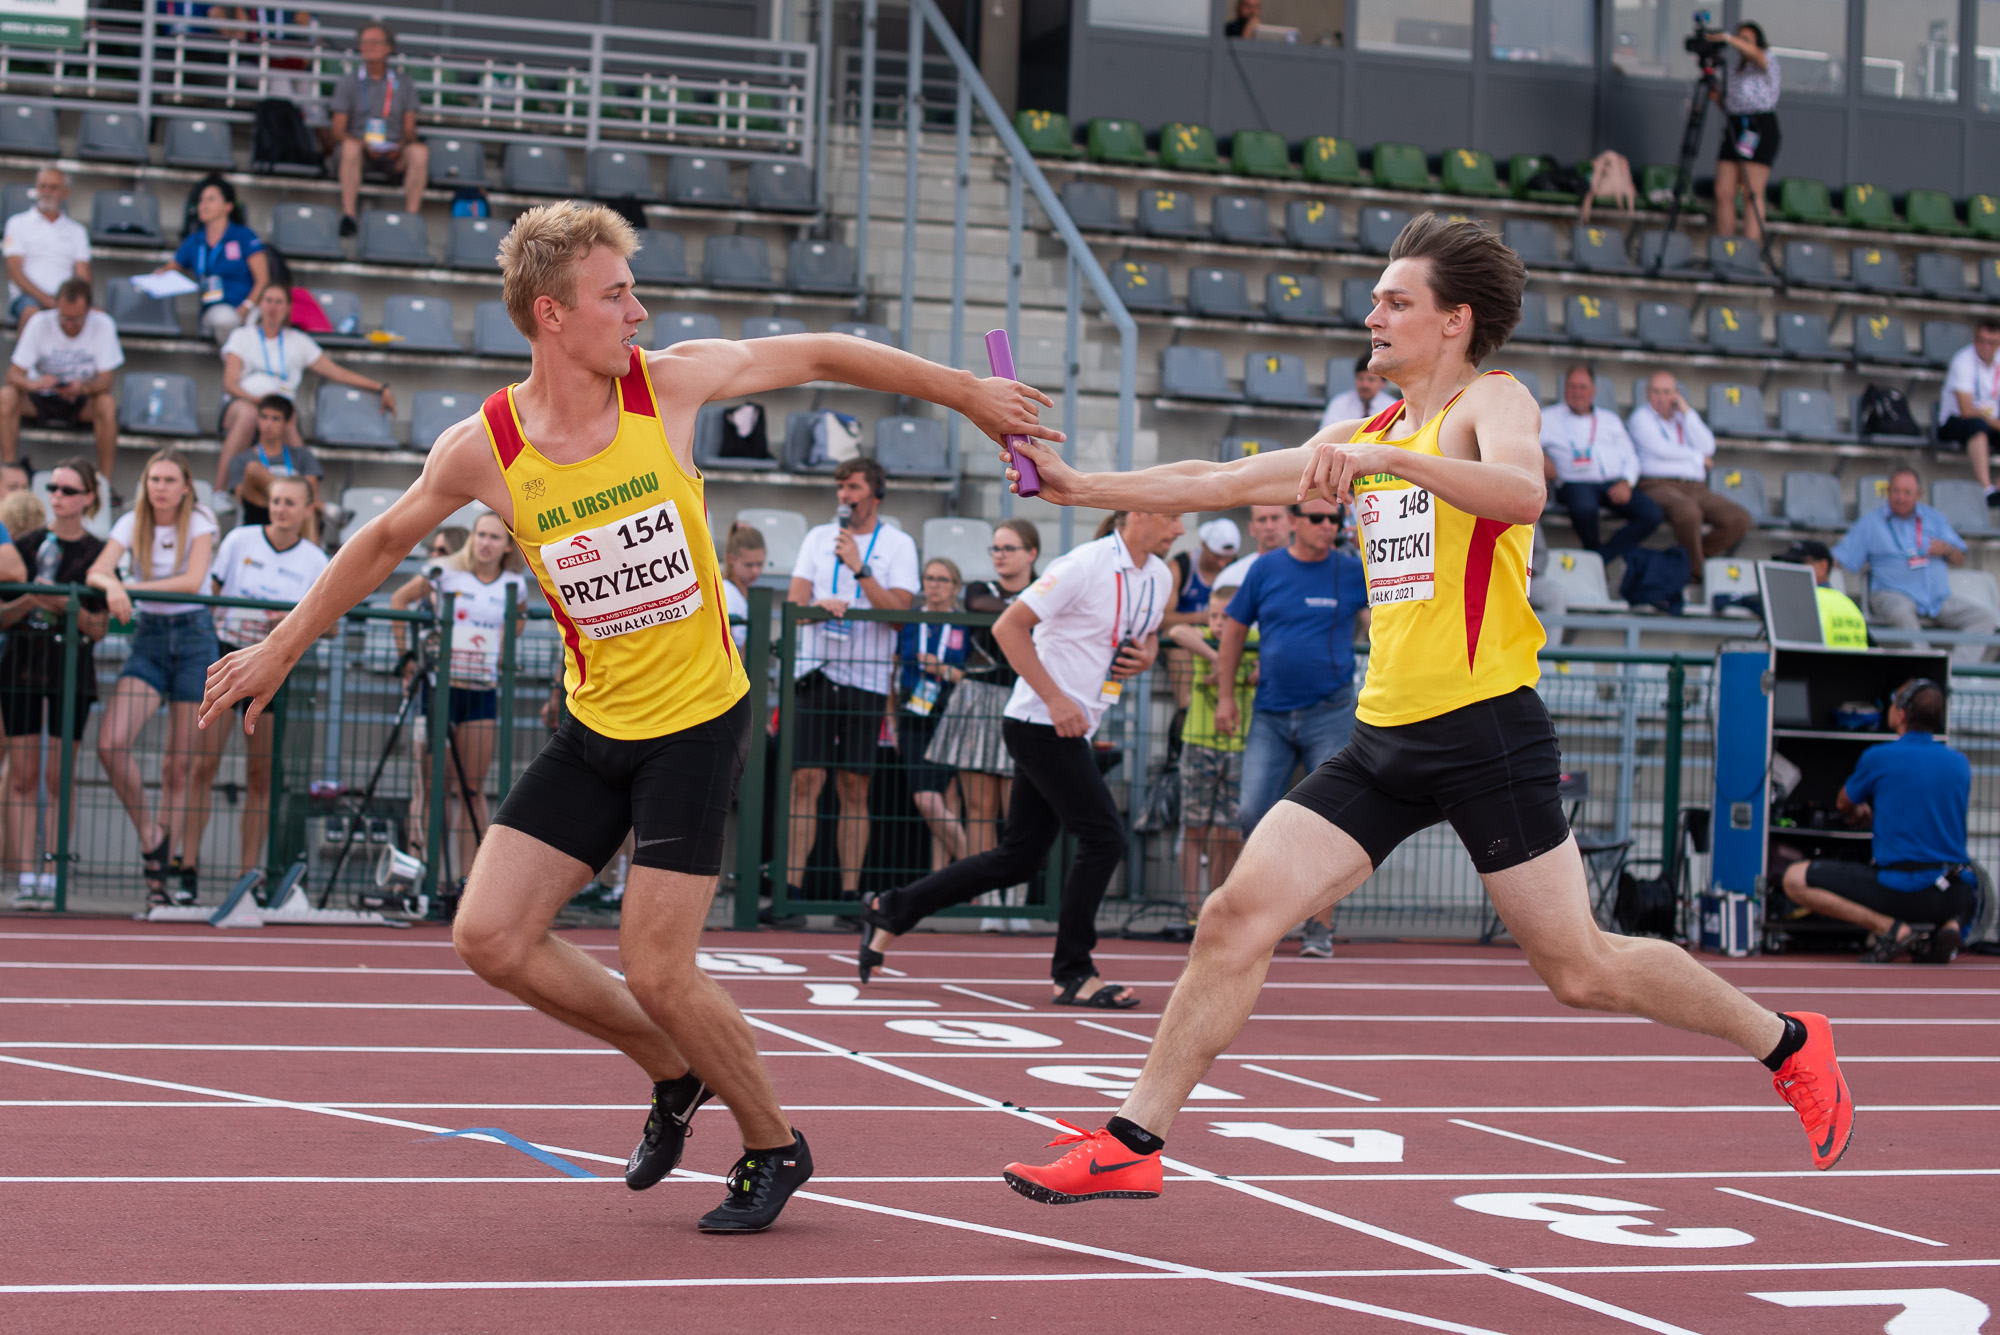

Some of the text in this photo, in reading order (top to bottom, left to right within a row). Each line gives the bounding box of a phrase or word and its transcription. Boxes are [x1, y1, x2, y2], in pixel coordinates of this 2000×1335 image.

[537, 471, 659, 532] AKL URSYNÓW
[1399, 489, 1429, 519] 148
[617, 509, 674, 550] 154
[559, 551, 598, 568] ORLEN
[559, 548, 690, 605] PRZYŻECKI
[586, 616, 606, 624] PZLA
[606, 603, 658, 620] MISTRZOSTWA
[659, 594, 684, 607] POLSKI
[1394, 587, 1414, 601] 2021
[593, 604, 688, 638] SUWAŁKI 2021
[1208, 1121, 1404, 1163] 4
[1454, 1192, 1756, 1248] 3
